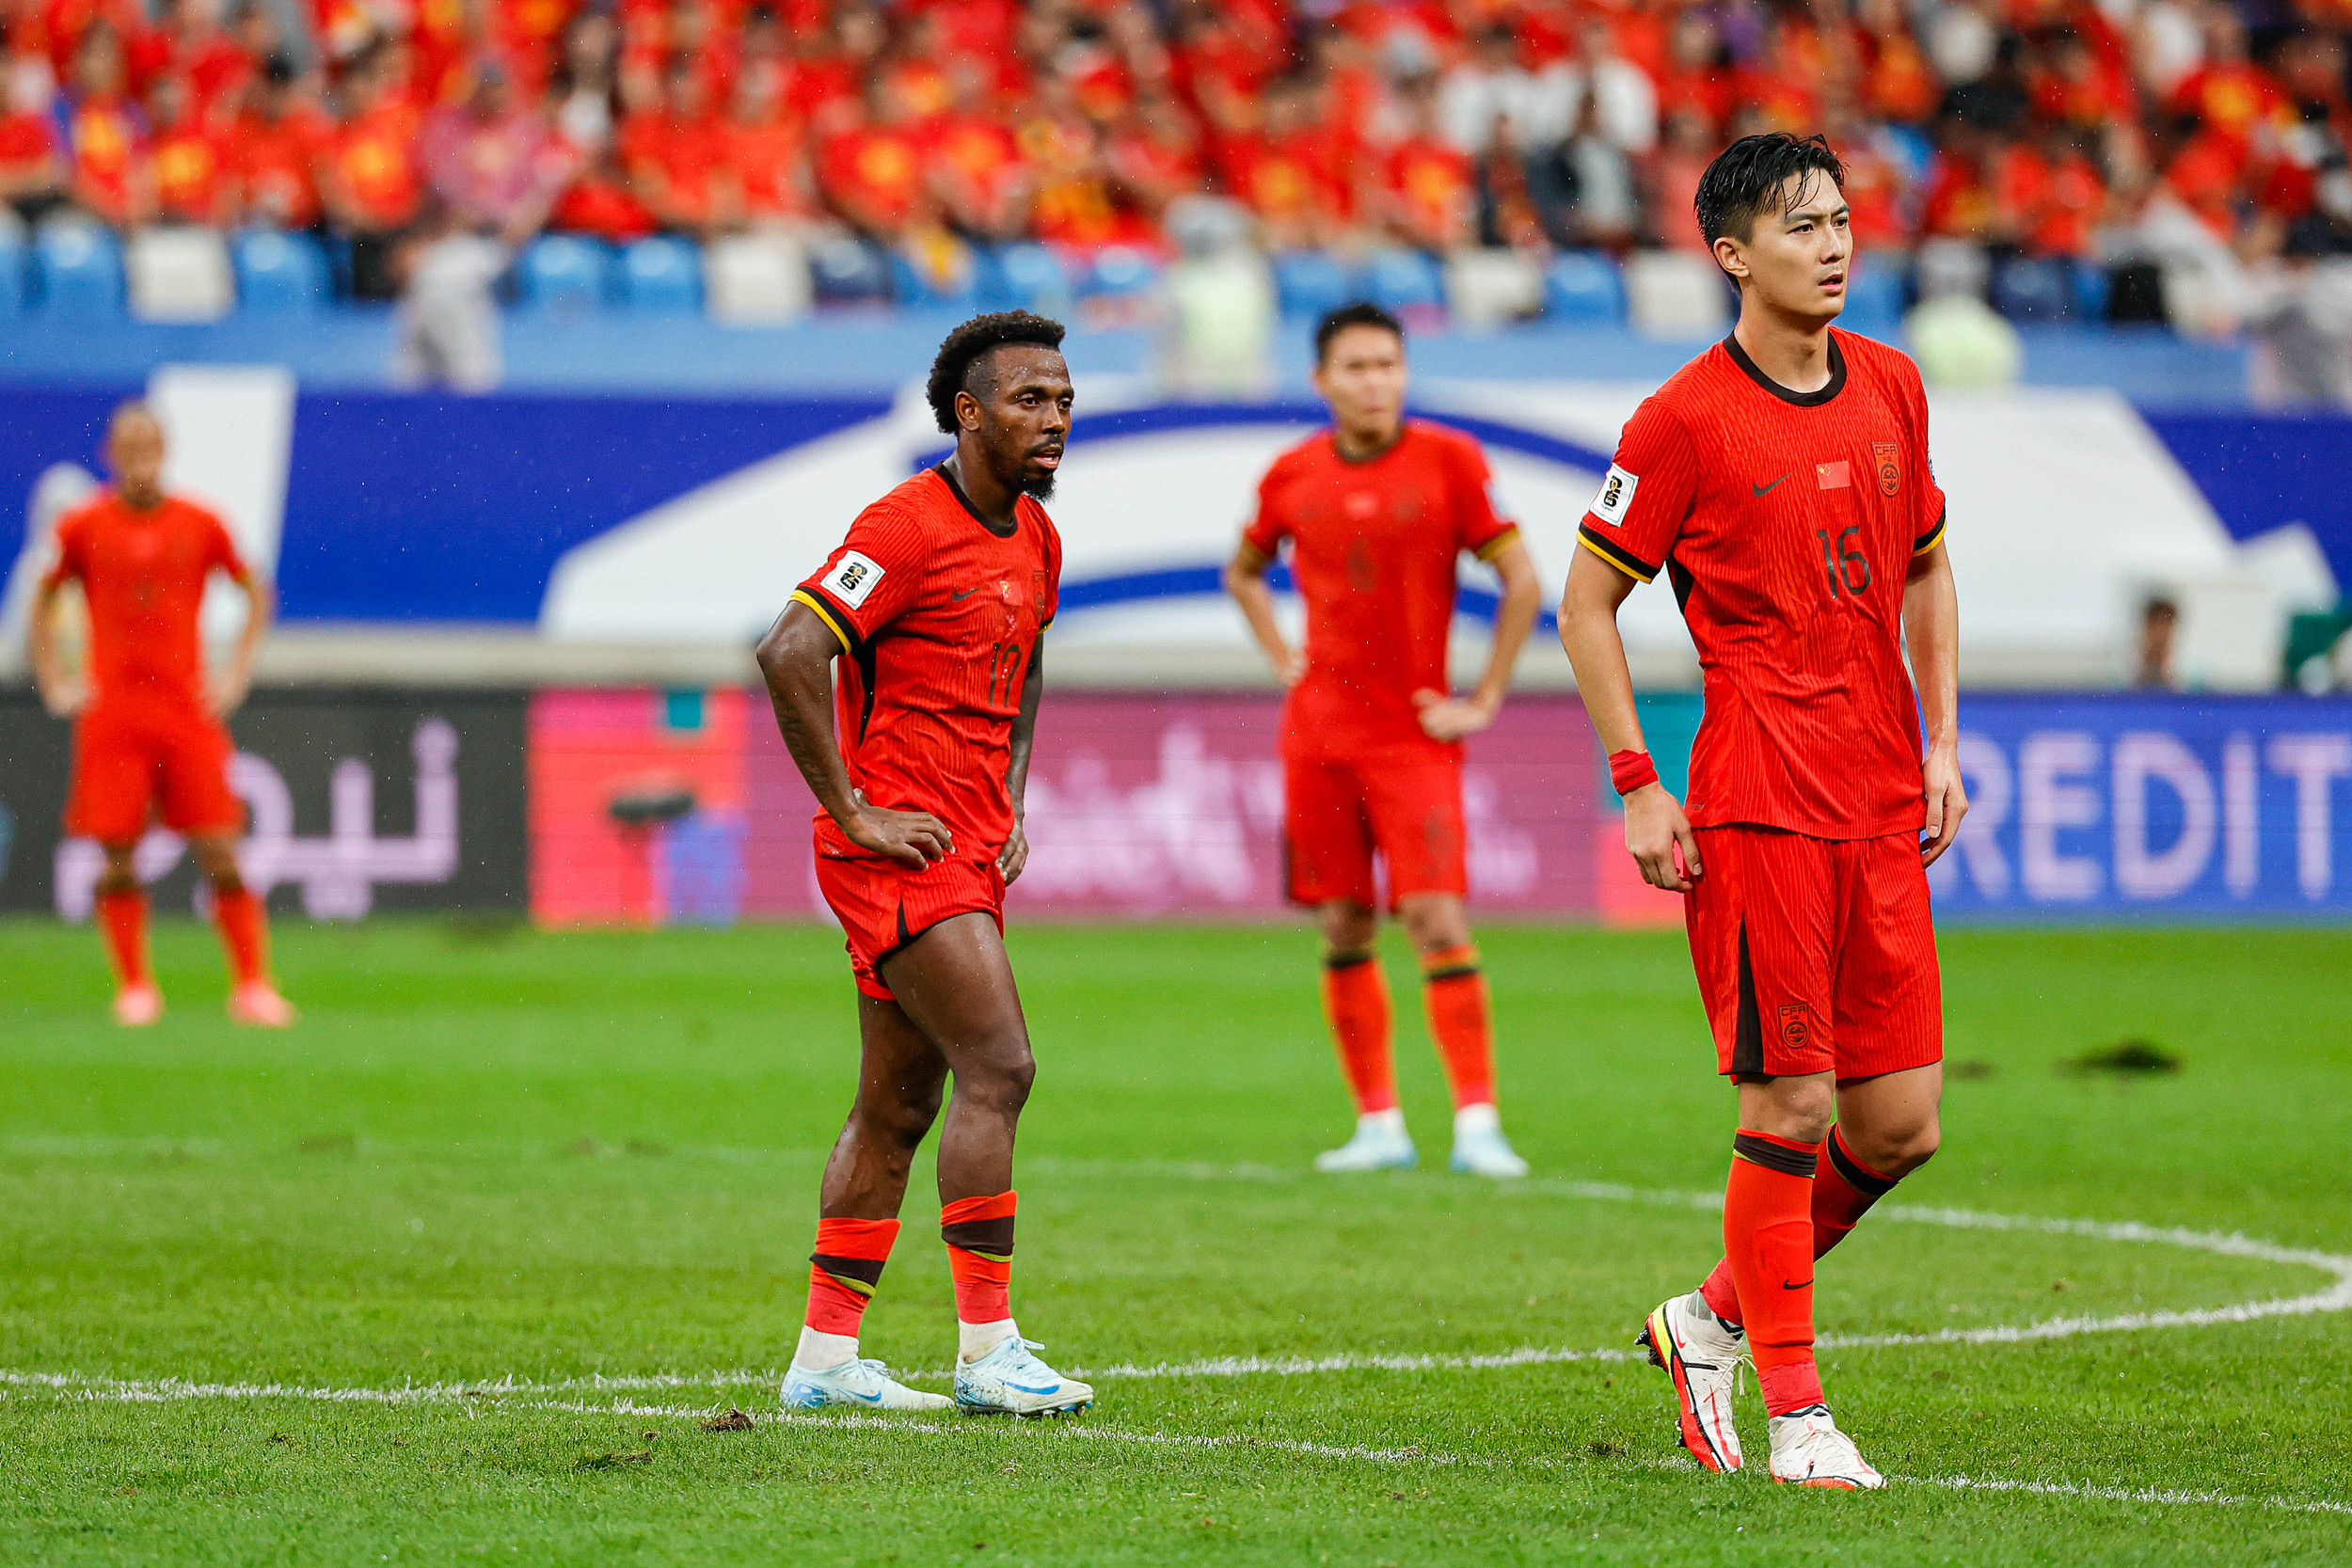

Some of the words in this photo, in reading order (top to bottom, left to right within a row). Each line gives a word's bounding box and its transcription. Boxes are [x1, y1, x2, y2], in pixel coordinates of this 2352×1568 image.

[1875, 446, 1897, 455] CFA
[1817, 525, 1870, 598] 16
[989, 642, 1022, 707] 17
[1781, 1006, 1806, 1016] CFA
